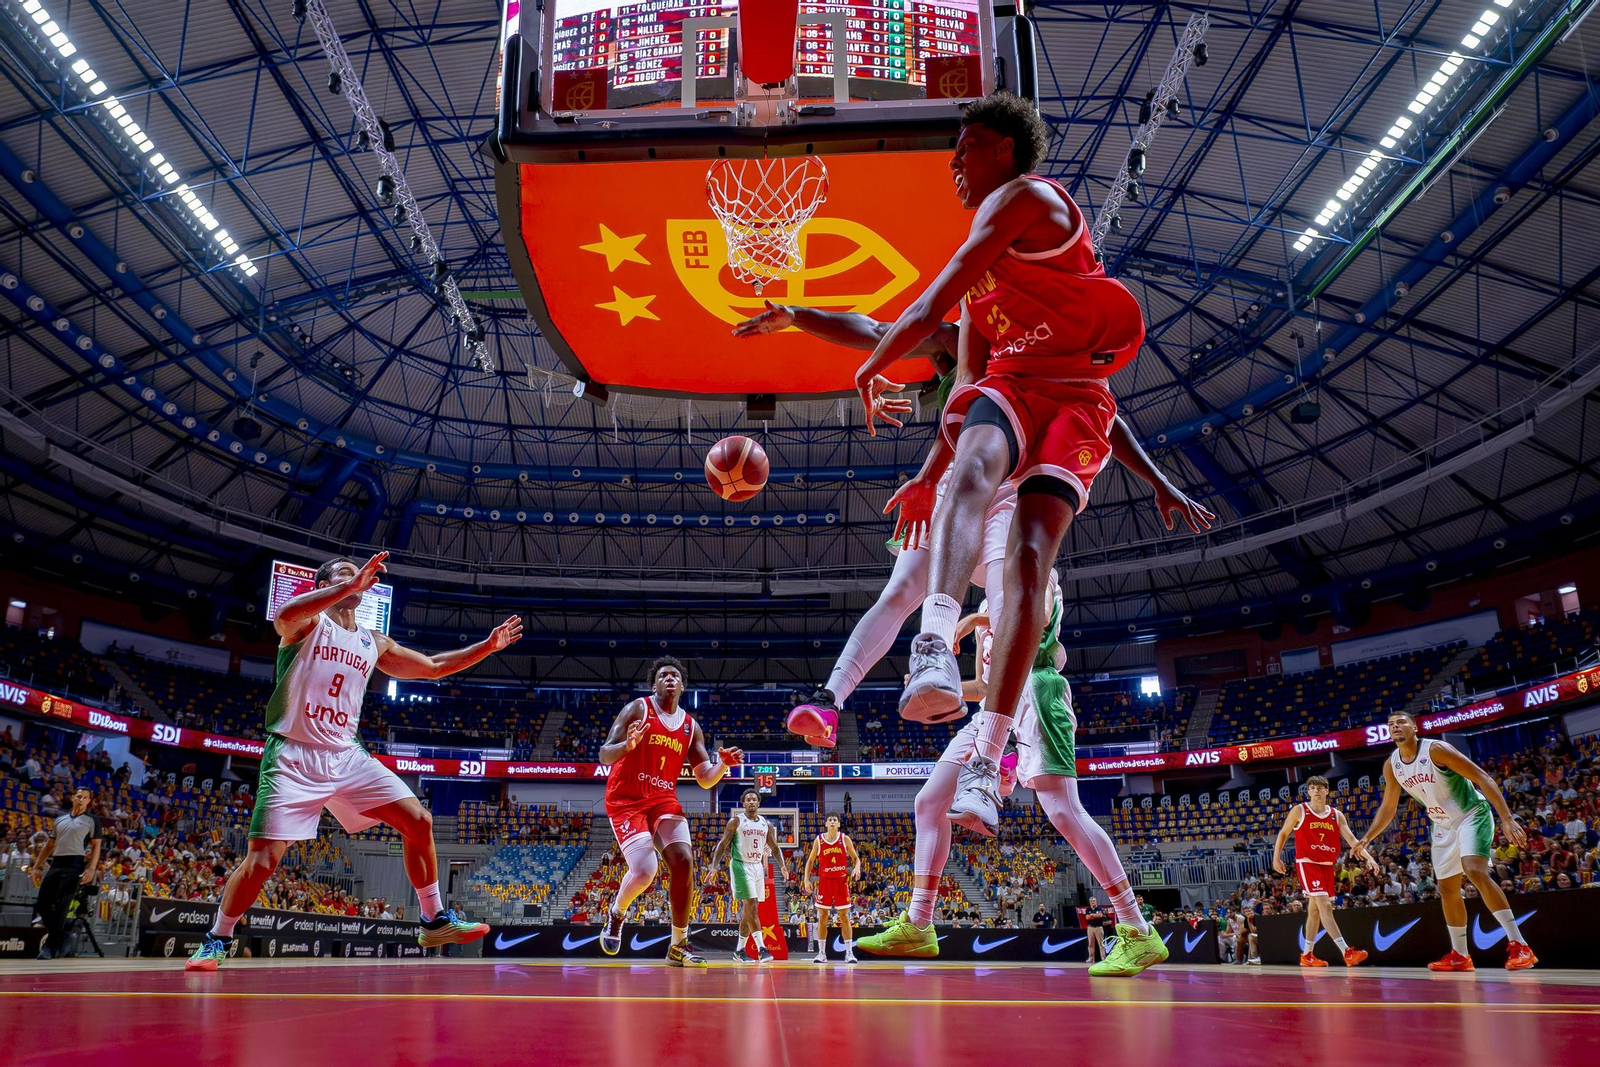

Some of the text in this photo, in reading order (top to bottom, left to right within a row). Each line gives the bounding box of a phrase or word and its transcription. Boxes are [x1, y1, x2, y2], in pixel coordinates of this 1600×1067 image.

[934, 29, 957, 41] SILVA
[682, 230, 710, 269] FEB
[313, 645, 371, 679] PORTUGAL
[328, 673, 345, 698] 9
[1524, 683, 1560, 708] AVIS
[87, 711, 128, 733] Wilson
[151, 723, 182, 744] SDI
[1365, 724, 1391, 743] SD
[648, 733, 684, 756] ESPAÑA
[1292, 739, 1339, 753] Wilson
[659, 755, 667, 772] 1
[1185, 750, 1221, 766] AVIS
[396, 759, 436, 772] Wilson
[459, 761, 486, 775] SDI
[593, 766, 612, 777] AV
[819, 766, 835, 777] 15
[886, 767, 931, 776] PORTUGAL
[757, 774, 775, 788] 15
[753, 838, 759, 849] 5
[1319, 832, 1326, 843] 7
[831, 856, 837, 865] 4
[178, 910, 211, 925] endesa
[710, 928, 739, 937] endes
